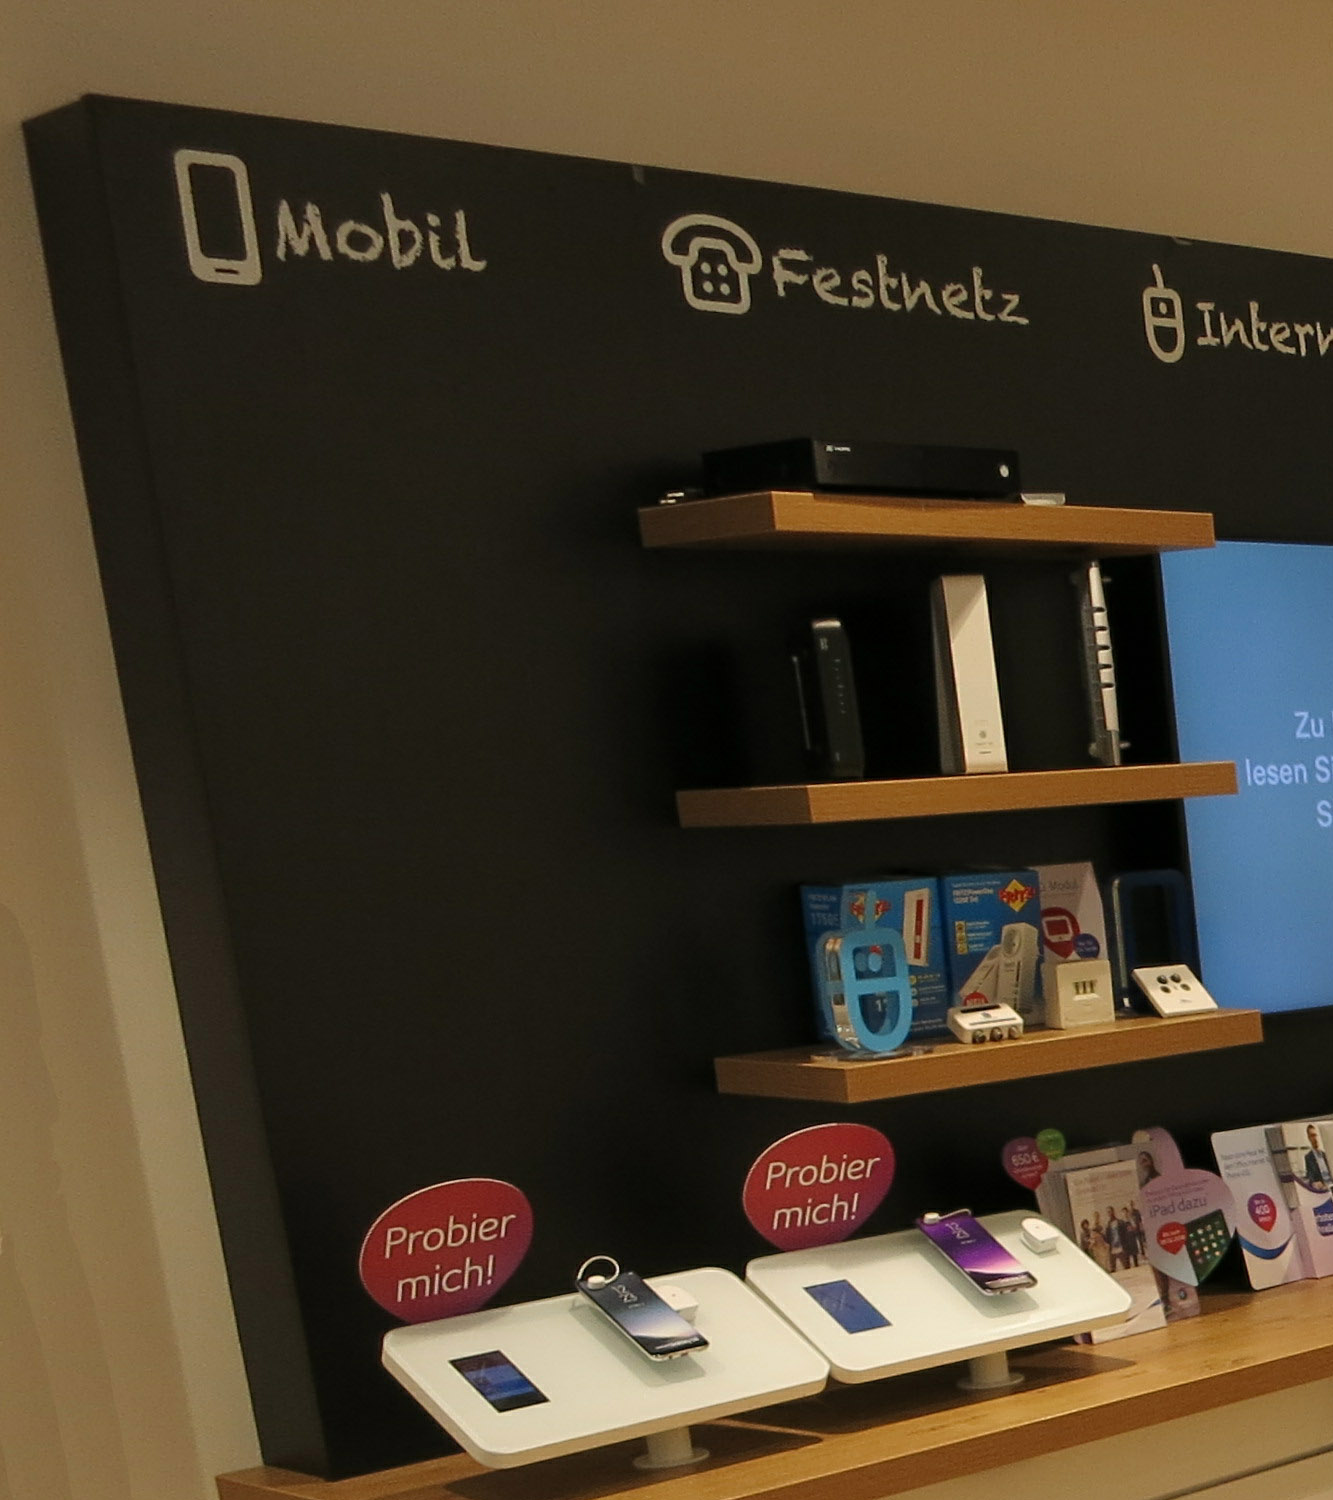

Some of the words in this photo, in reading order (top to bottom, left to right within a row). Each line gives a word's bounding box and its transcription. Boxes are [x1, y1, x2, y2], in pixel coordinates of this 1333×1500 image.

[275, 192, 487, 274] Mobil
[771, 247, 1031, 326] Festnetz
[1293, 710, 1325, 740] Zu
[1245, 758, 1308, 787] lesen
[765, 1154, 881, 1191] Probier
[772, 1192, 860, 1232] mich!
[385, 1209, 517, 1260] Probier
[397, 1255, 497, 1303] mich!
